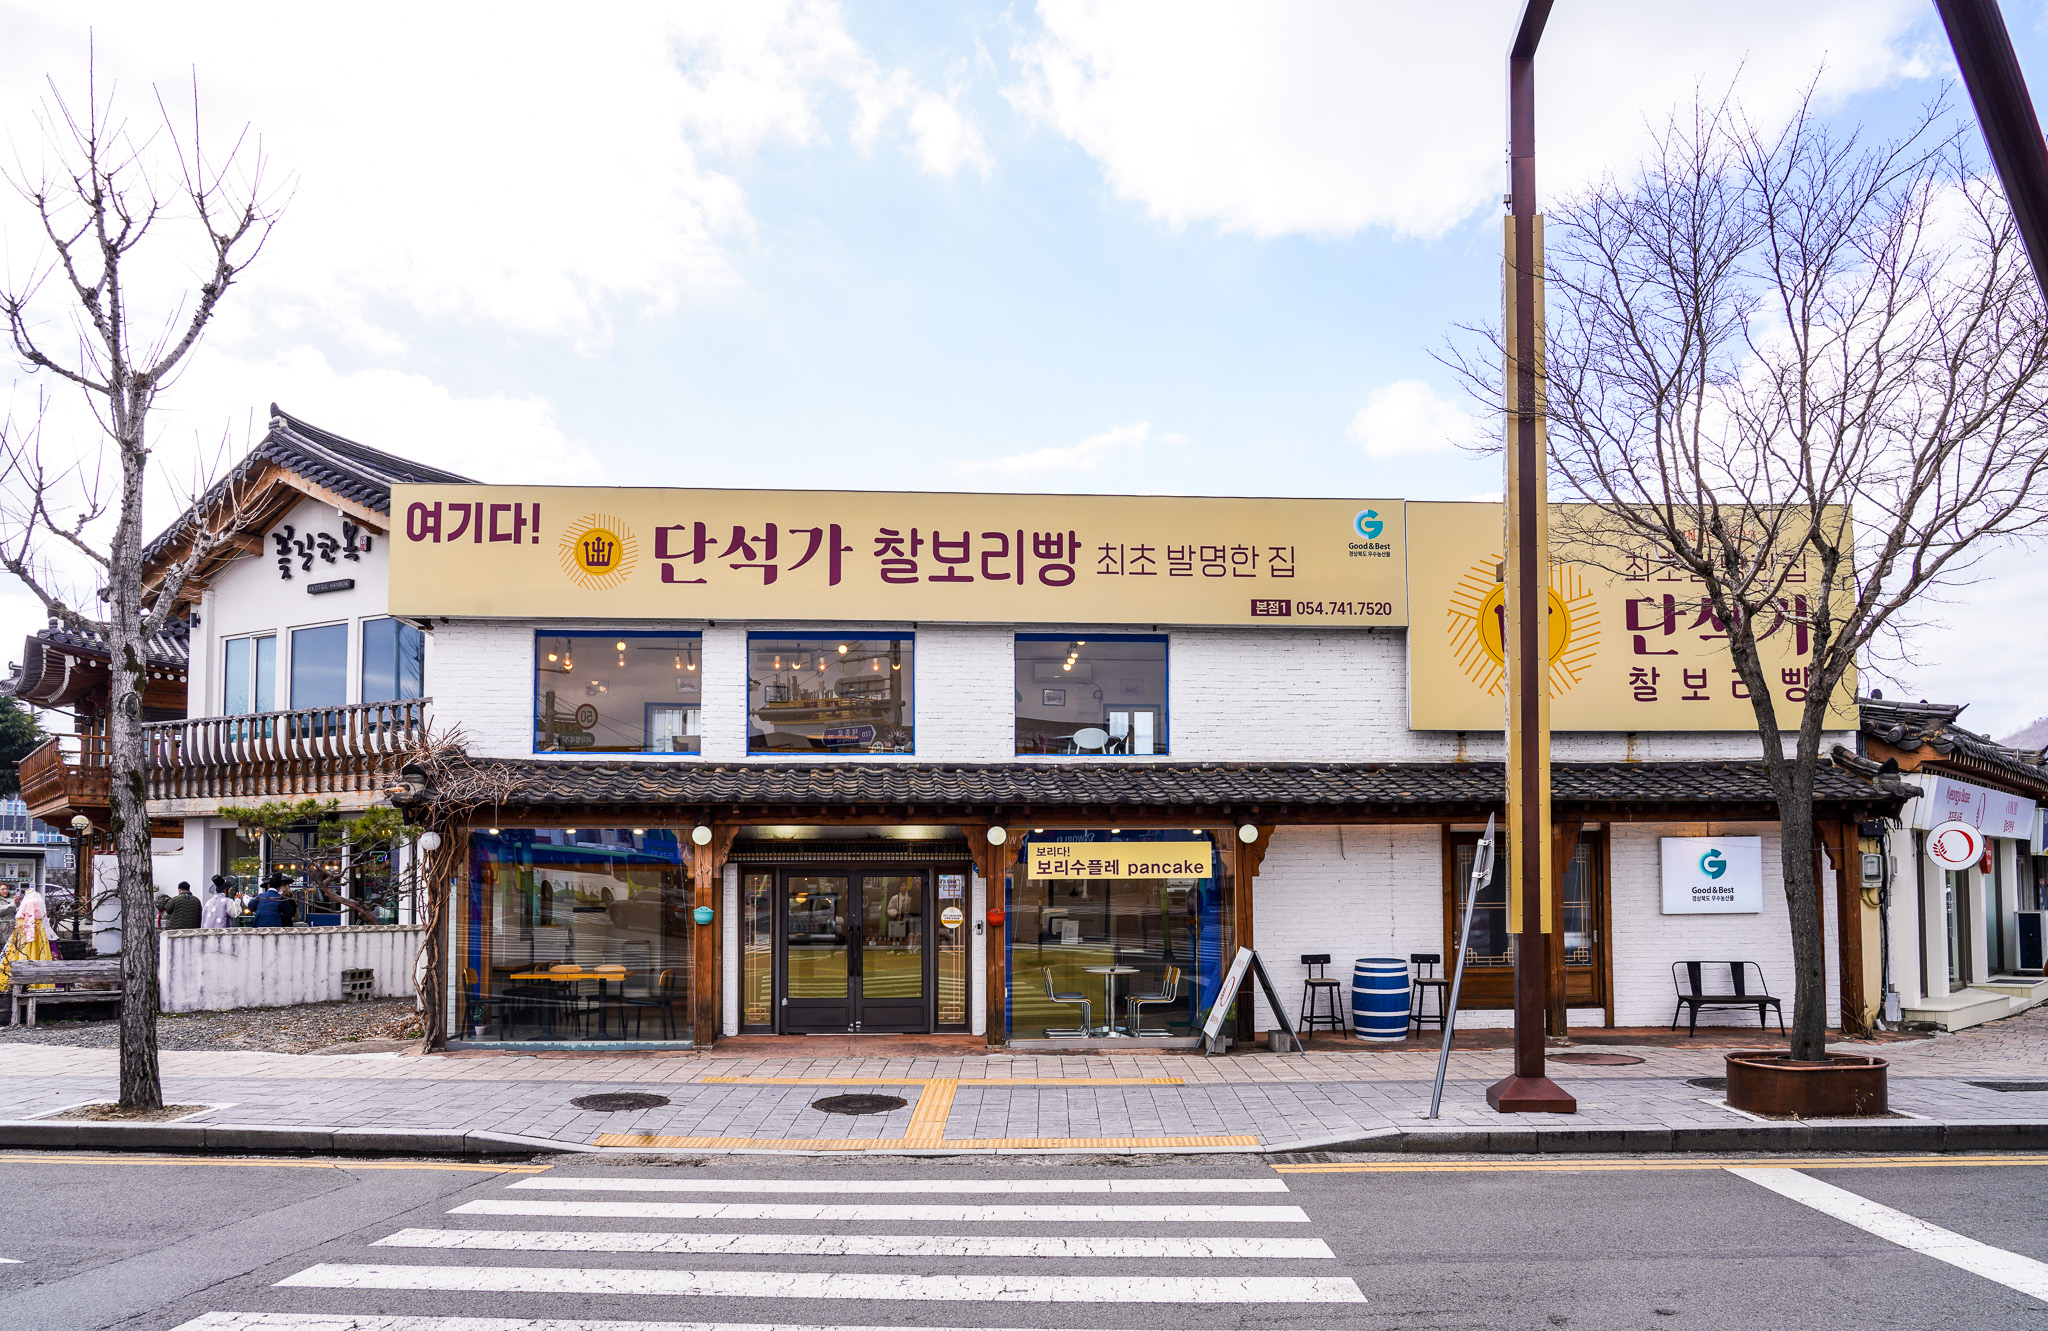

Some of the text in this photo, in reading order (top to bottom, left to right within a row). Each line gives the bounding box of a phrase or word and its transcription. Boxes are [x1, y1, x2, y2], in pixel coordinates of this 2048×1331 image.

[406, 501, 541, 545] 여기다!
[654, 521, 1295, 587] 단석가 찰보리빵 최초 발명한 집
[1296, 601, 1392, 616] 054.741.7520
[1036, 846, 1070, 857] 보리다!
[1036, 859, 1205, 876] 보리수플레 pancake
